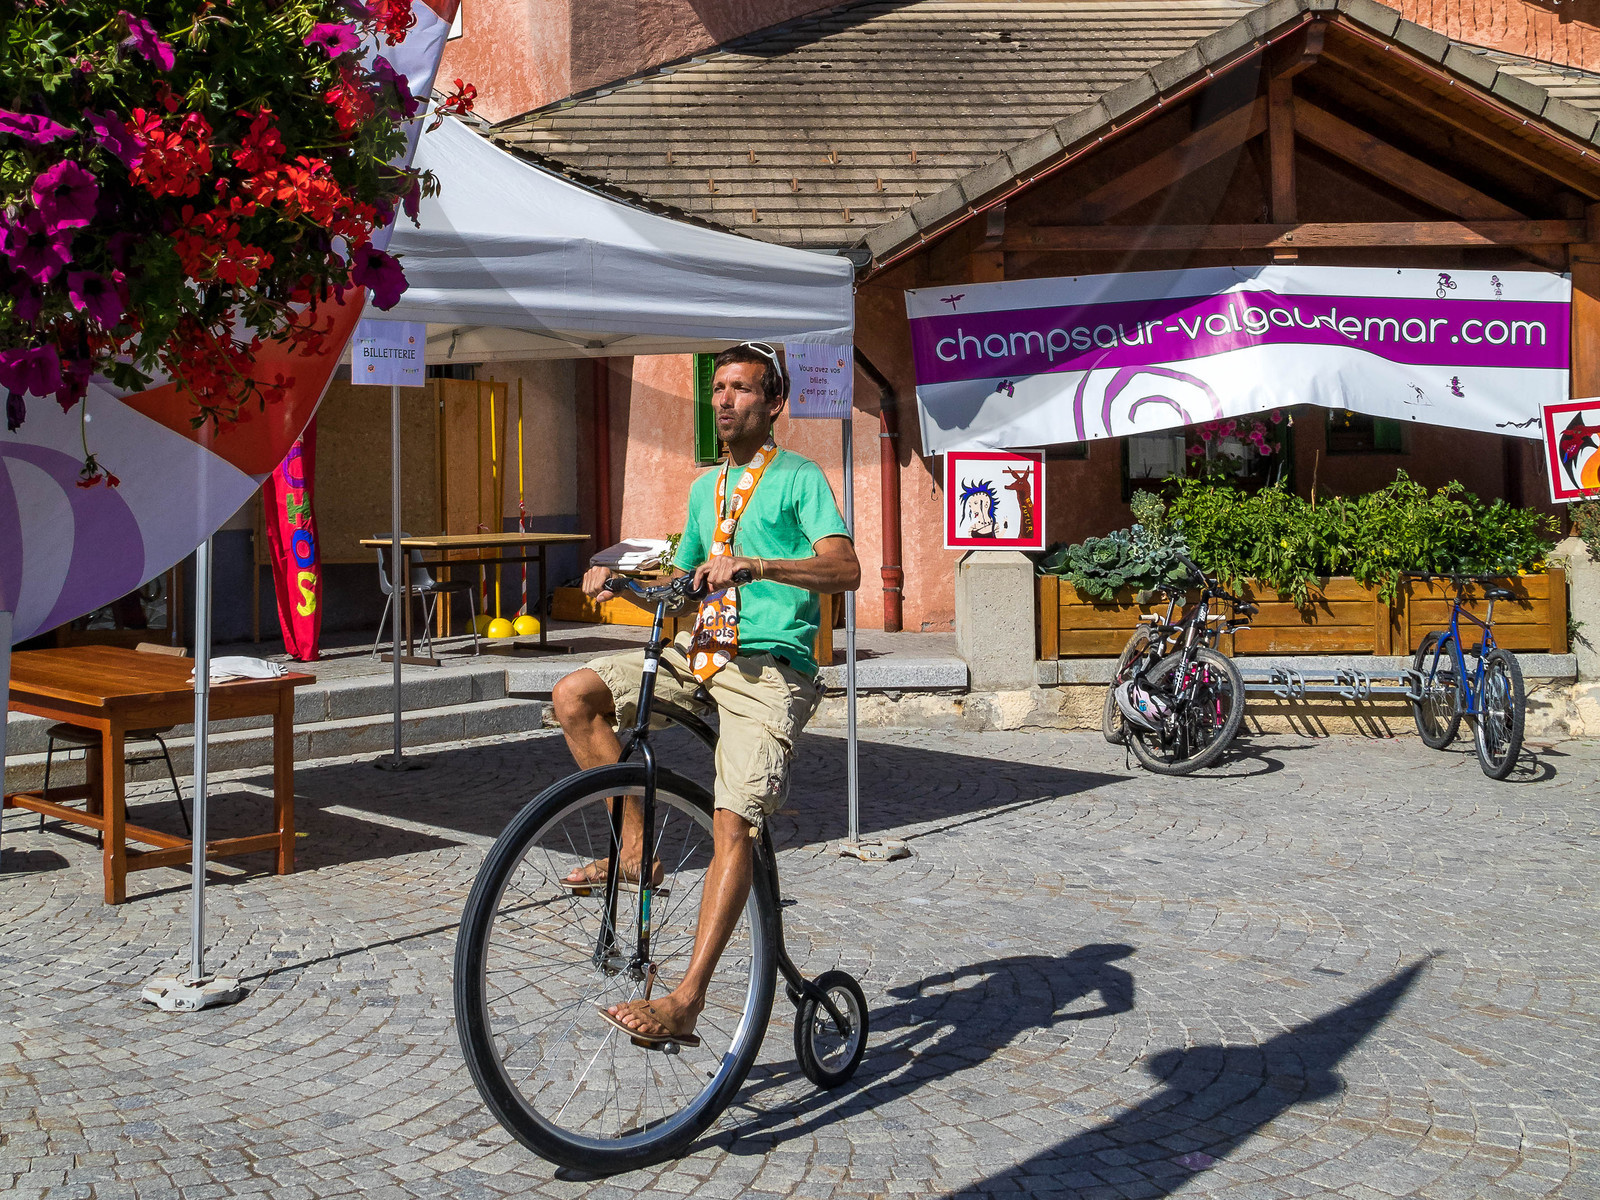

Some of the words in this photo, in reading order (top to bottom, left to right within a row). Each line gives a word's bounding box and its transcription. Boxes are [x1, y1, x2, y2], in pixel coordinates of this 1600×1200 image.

[935, 302, 1547, 363] champsaur-valgaudemar.com
[363, 347, 416, 360] BILLETTERIE
[798, 363, 814, 373] Vous
[282, 436, 318, 618] CHOS
